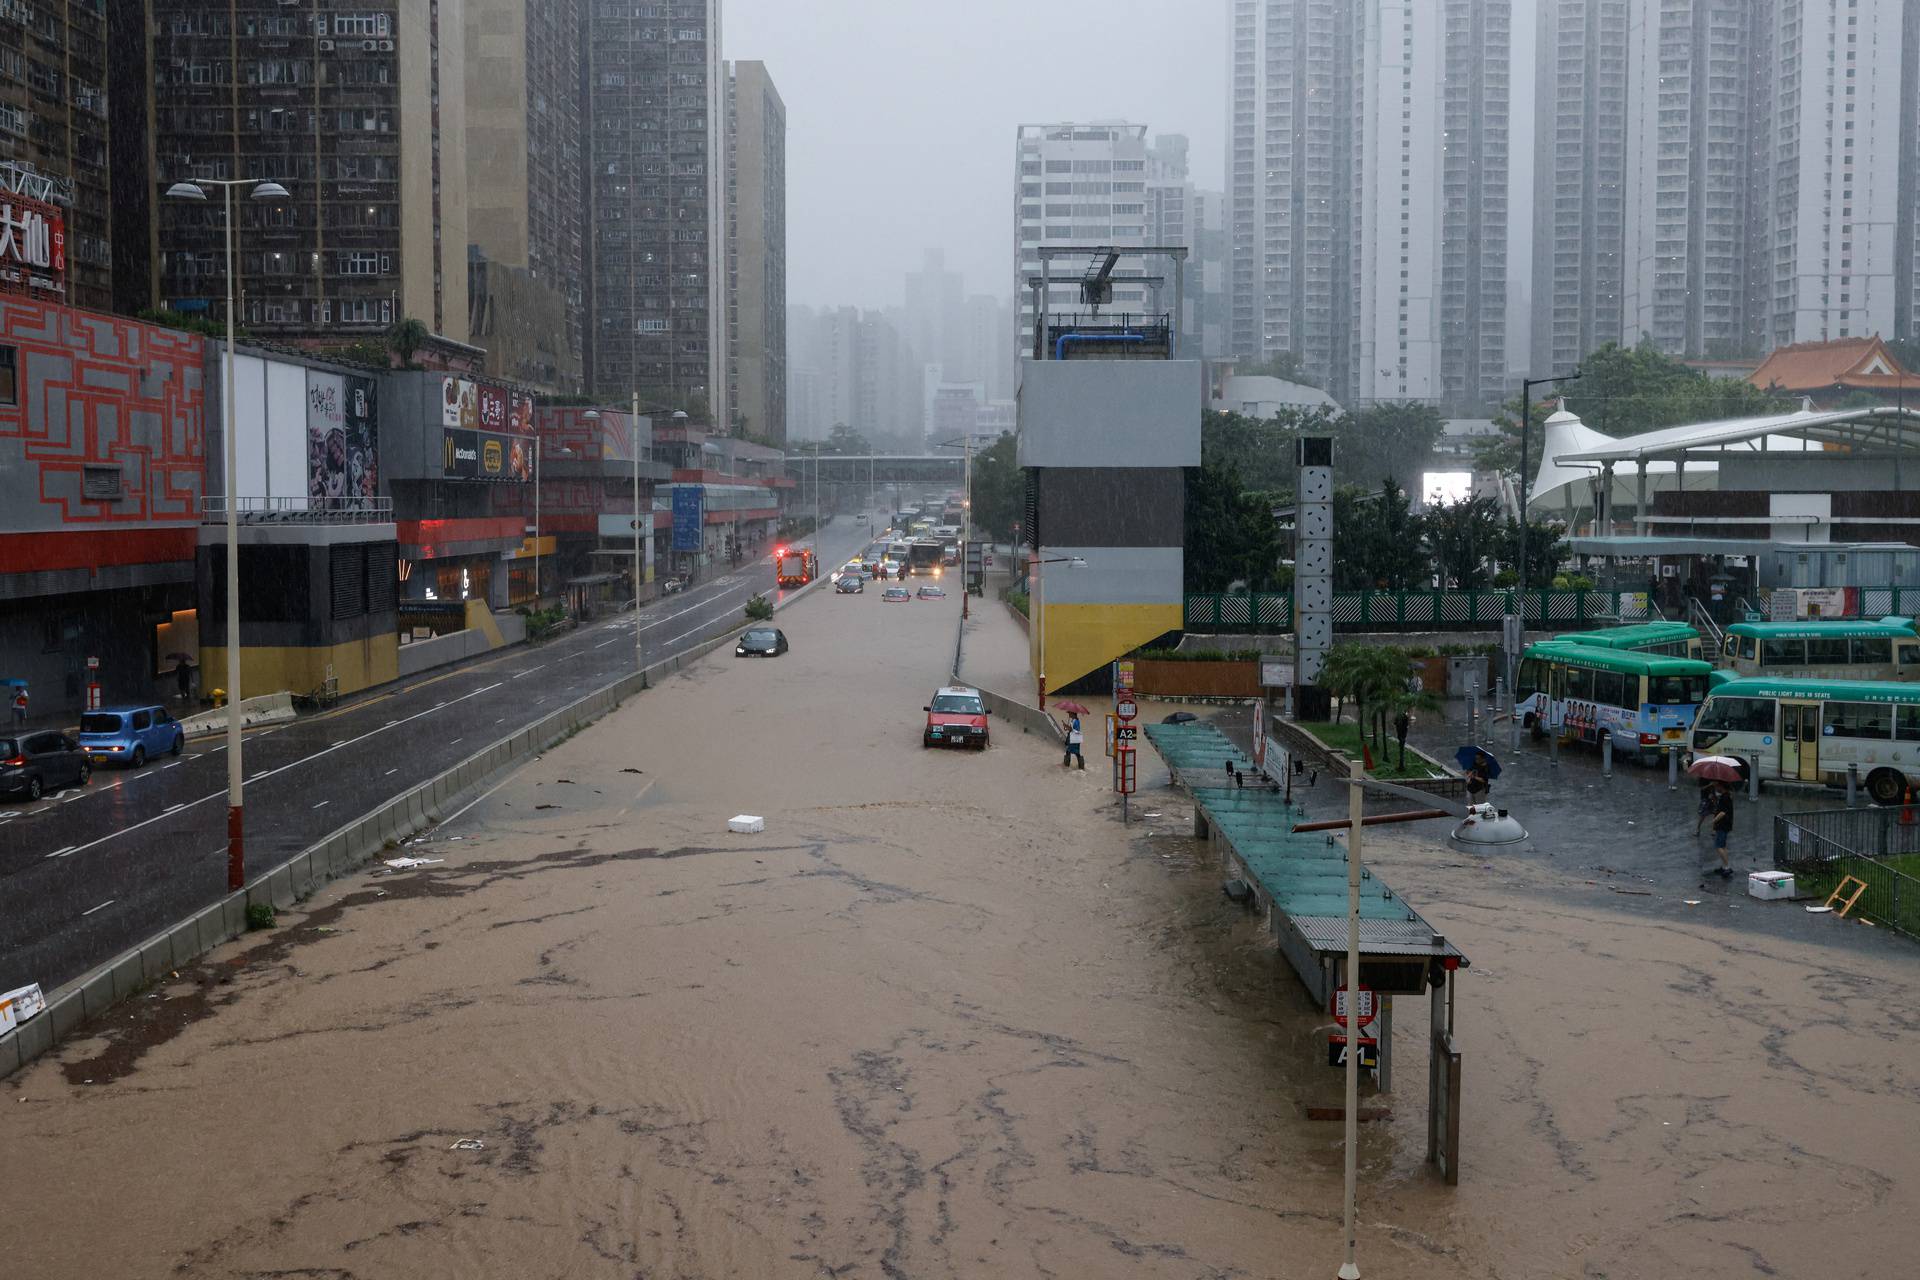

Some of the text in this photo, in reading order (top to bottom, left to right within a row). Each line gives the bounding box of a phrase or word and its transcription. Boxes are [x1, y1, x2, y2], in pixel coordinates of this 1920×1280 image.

[54, 230, 65, 270] 中心
[455, 447, 477, 460] McDonald's
[1119, 728, 1134, 739] A2
[1337, 1046, 1366, 1066] A1
